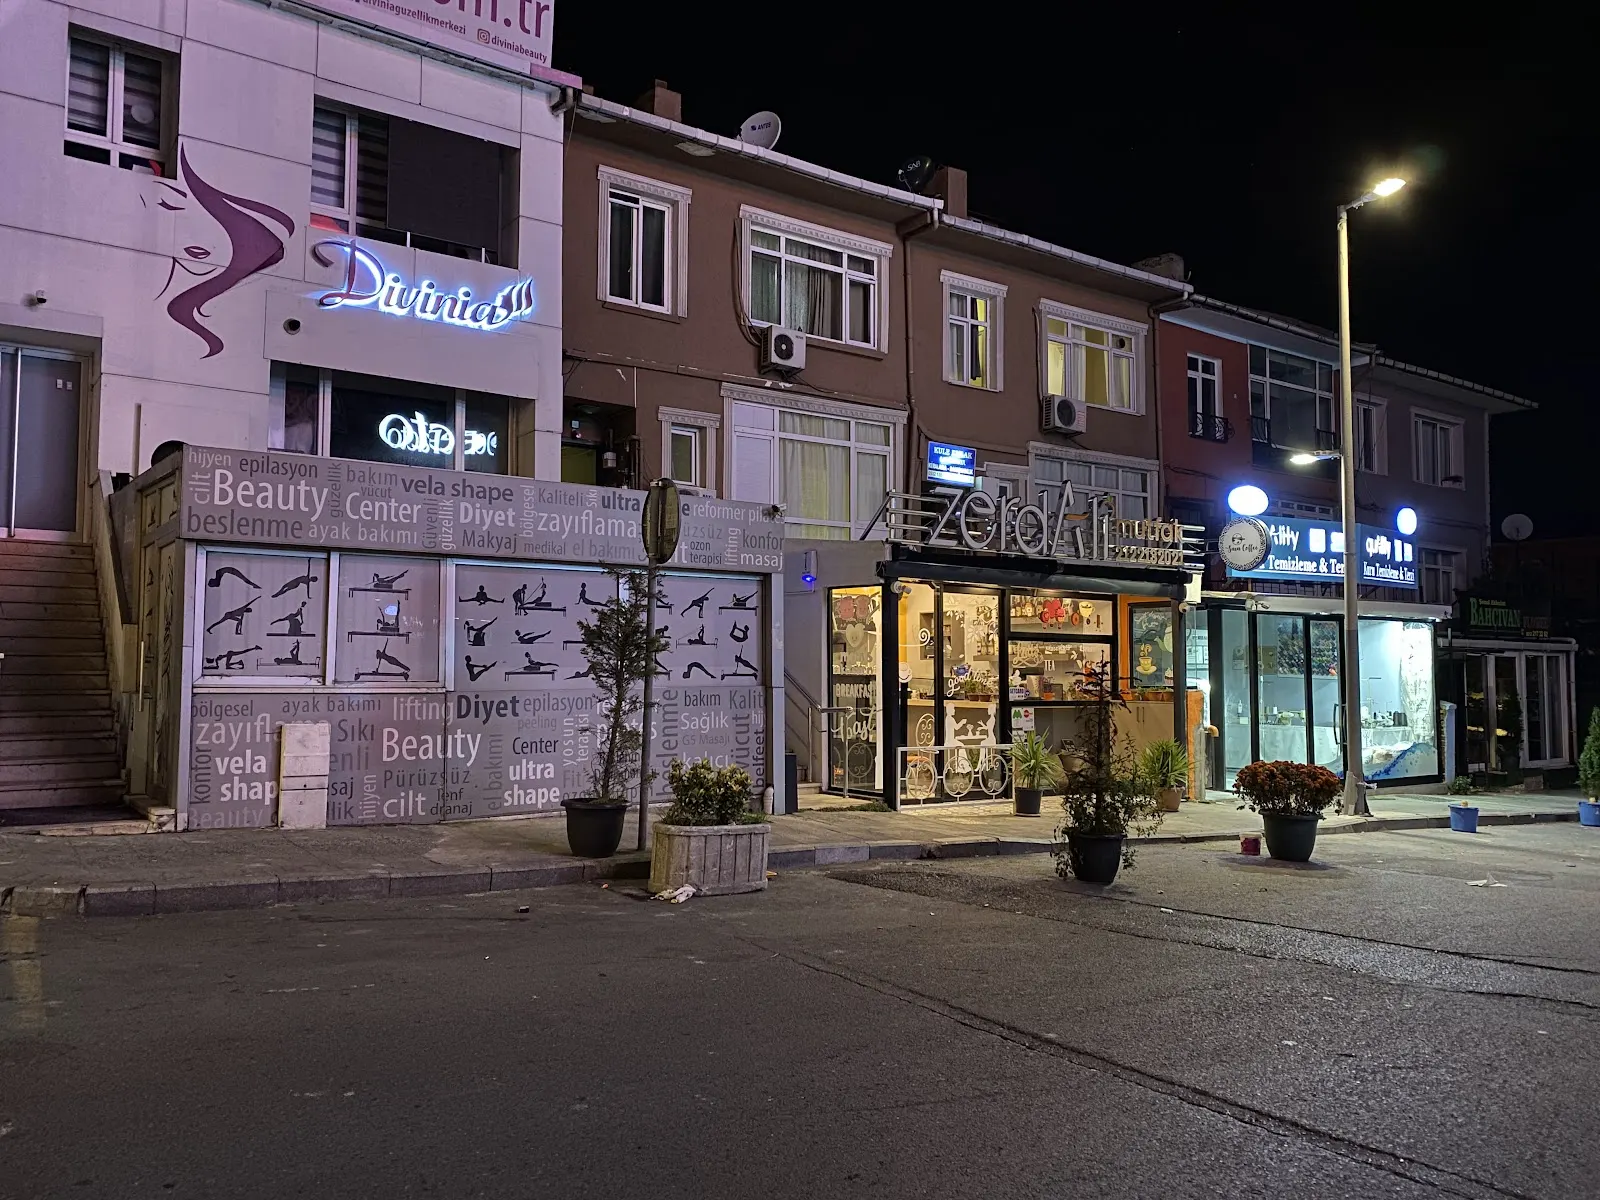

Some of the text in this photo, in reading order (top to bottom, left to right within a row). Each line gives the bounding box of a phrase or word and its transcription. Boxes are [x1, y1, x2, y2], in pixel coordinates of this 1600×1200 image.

[491, 36, 548, 64] diviniabeauty
[312, 239, 532, 328] Divinia
[188, 448, 232, 468] hijyen
[239, 456, 318, 480] epilasyon
[346, 464, 398, 486] bakım
[189, 471, 211, 504] cilt
[214, 469, 328, 522] Beauty
[327, 462, 343, 518] güzellik
[361, 484, 392, 499] vücut
[401, 475, 514, 505] vela shape
[538, 487, 584, 507] Kaliteli
[345, 492, 421, 524] Center
[520, 485, 537, 538] bölgesel
[601, 491, 640, 511] ultra
[693, 501, 746, 522] reformer
[186, 506, 303, 539] beslenme
[438, 499, 456, 550] güzellik
[459, 502, 516, 531] Diyet
[537, 510, 637, 539] zayıflama
[308, 522, 417, 545] ayak bakımı
[462, 529, 518, 554] Makyaj
[742, 528, 784, 551] konfor
[524, 542, 566, 555] medikal
[572, 539, 584, 555] el
[690, 540, 711, 552] ozon
[724, 527, 742, 566] lifting
[690, 551, 722, 566] terapisi
[740, 552, 783, 571] masaj
[1268, 554, 1317, 572] Temizleme
[1319, 557, 1328, 573] &
[282, 695, 381, 717] ayak bakımı
[456, 694, 519, 725] Diyet
[523, 692, 593, 716] epilasyon
[684, 690, 720, 707] bakım
[393, 696, 454, 726] lifting
[681, 711, 729, 734] Sağlık
[337, 718, 375, 742] Sıkı
[517, 716, 557, 733] peeling
[382, 727, 481, 767] Beauty
[512, 736, 559, 755] Center
[563, 717, 577, 767] yosun
[731, 713, 750, 769] vücut
[214, 749, 267, 775] vela
[508, 758, 555, 781] ultra
[383, 767, 470, 789] Pürüzsüz
[220, 776, 279, 805] shap
[358, 774, 381, 819] hijyen
[503, 784, 561, 809] shape
[383, 789, 426, 819] cilt
[431, 800, 473, 816] dranaj
[483, 797, 502, 811] el
